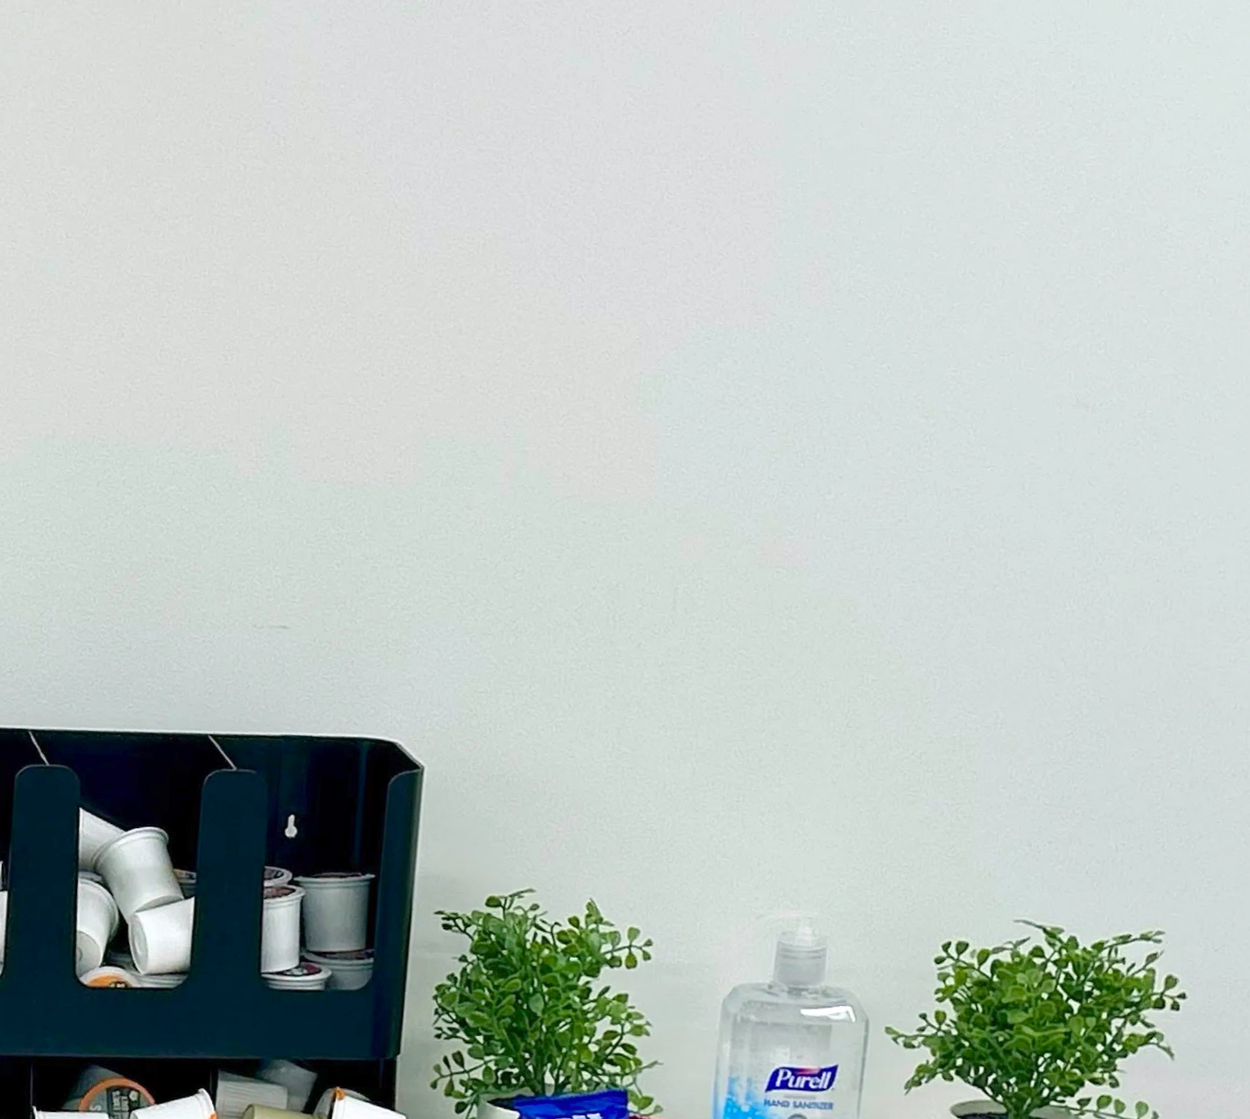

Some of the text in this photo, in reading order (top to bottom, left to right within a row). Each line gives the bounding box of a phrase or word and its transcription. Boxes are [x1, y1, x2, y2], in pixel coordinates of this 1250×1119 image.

[775, 1068, 832, 1089] Purell
[763, 1098, 834, 1110] HAND SANITIZER
